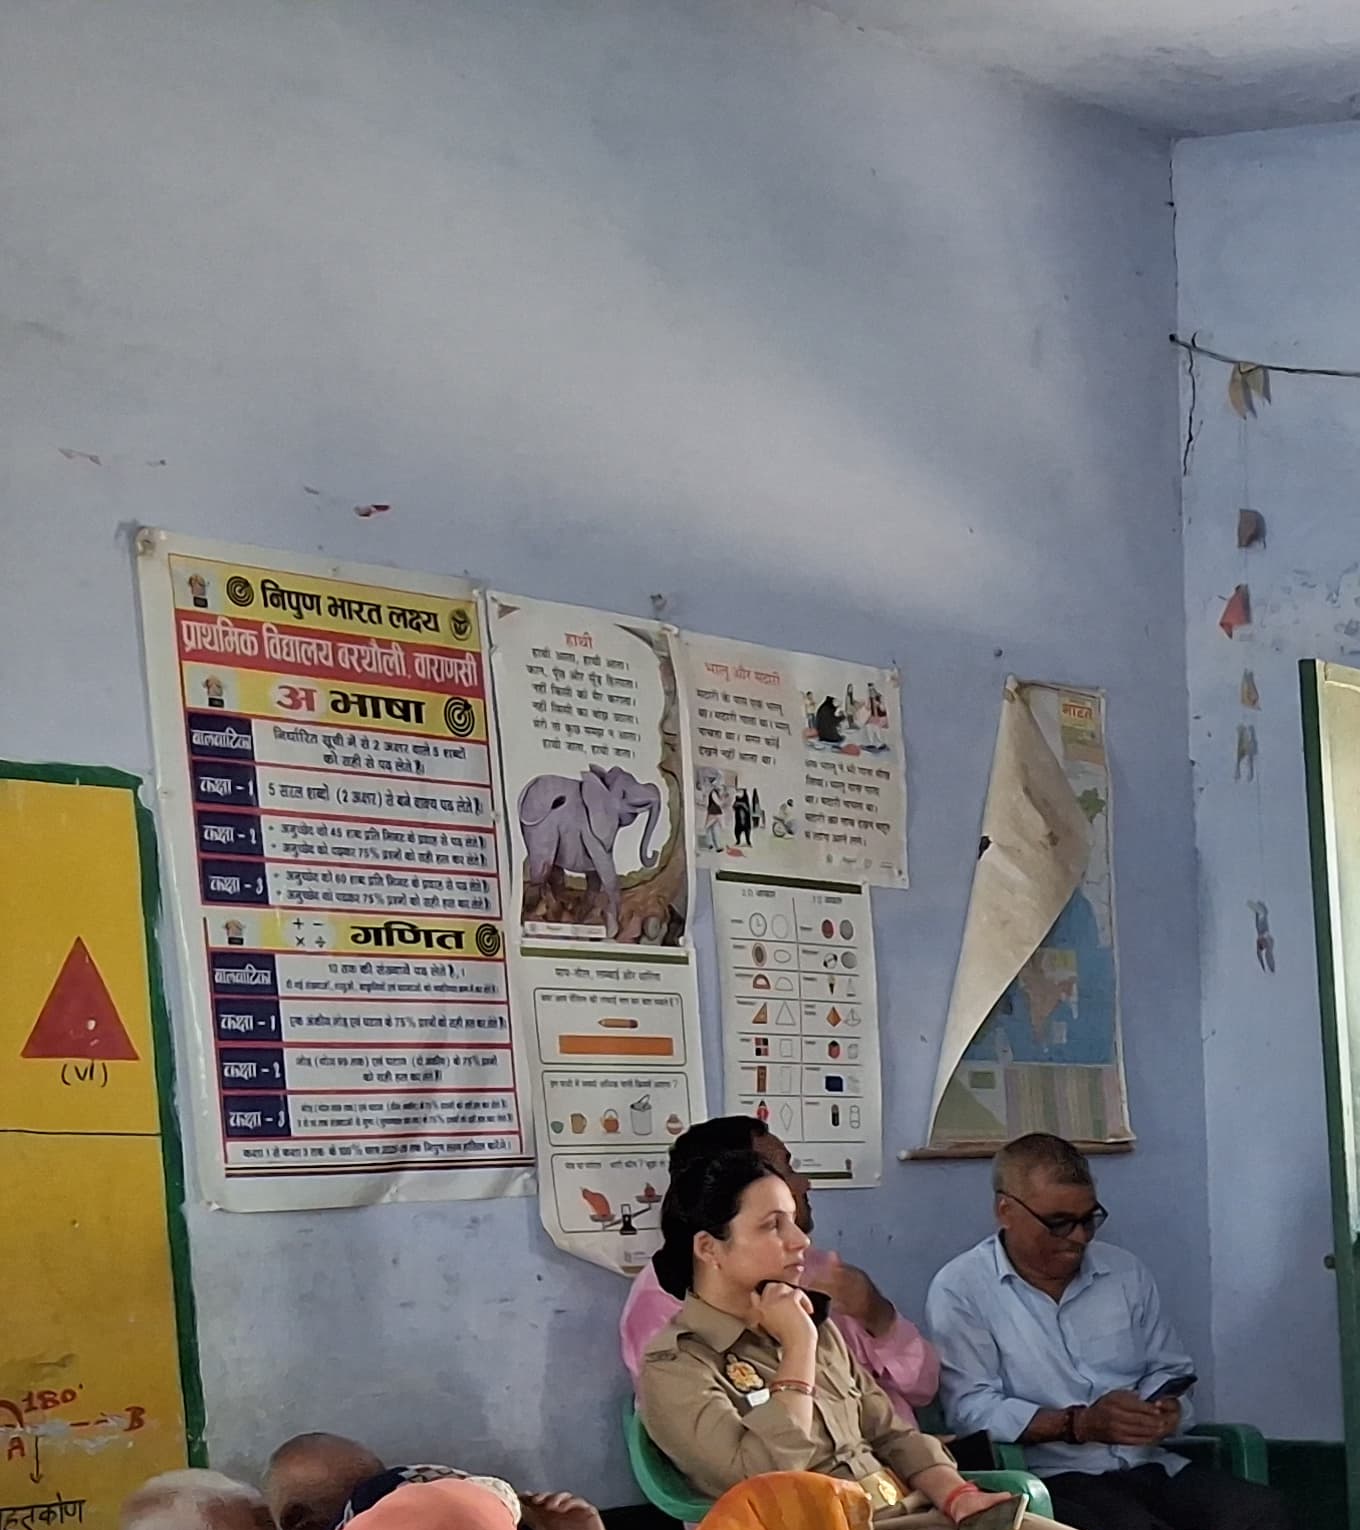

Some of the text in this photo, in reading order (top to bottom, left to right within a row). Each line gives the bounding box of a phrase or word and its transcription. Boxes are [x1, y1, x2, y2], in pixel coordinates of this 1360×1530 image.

[260, 579, 440, 633] निपुण भारत लक्ष्य
[565, 632, 592, 648] हाथी
[181, 616, 258, 656] प्राथमिक
[262, 623, 334, 666] विद्यालय
[413, 652, 478, 687] वाराणसी
[276, 684, 425, 724] अ भाषा
[1062, 703, 1092, 719] भारत
[191, 727, 252, 750] बालवाटिका
[273, 726, 318, 744] निर्धारित
[374, 740, 379, 751] 2
[323, 752, 338, 765] को
[199, 777, 232, 797] कक्षा
[248, 779, 254, 796] 1
[268, 782, 276, 796] 5
[278, 784, 303, 798] सरल
[203, 824, 234, 844] कक्षा
[250, 828, 256, 844] 2
[330, 827, 342, 838] 45
[209, 875, 240, 895] कक्षा
[256, 877, 263, 895] 3
[350, 921, 465, 950] गणित
[213, 964, 271, 985] बालवाटिका
[220, 1014, 253, 1032] कक्षा
[271, 1015, 275, 1032] 1
[223, 1062, 256, 1080] कक्षा
[273, 1061, 281, 1078] 2
[229, 1111, 262, 1129] कक्षा
[278, 1110, 285, 1128] 3
[124, 1406, 146, 1432] B
[7, 1436, 26, 1461] A
